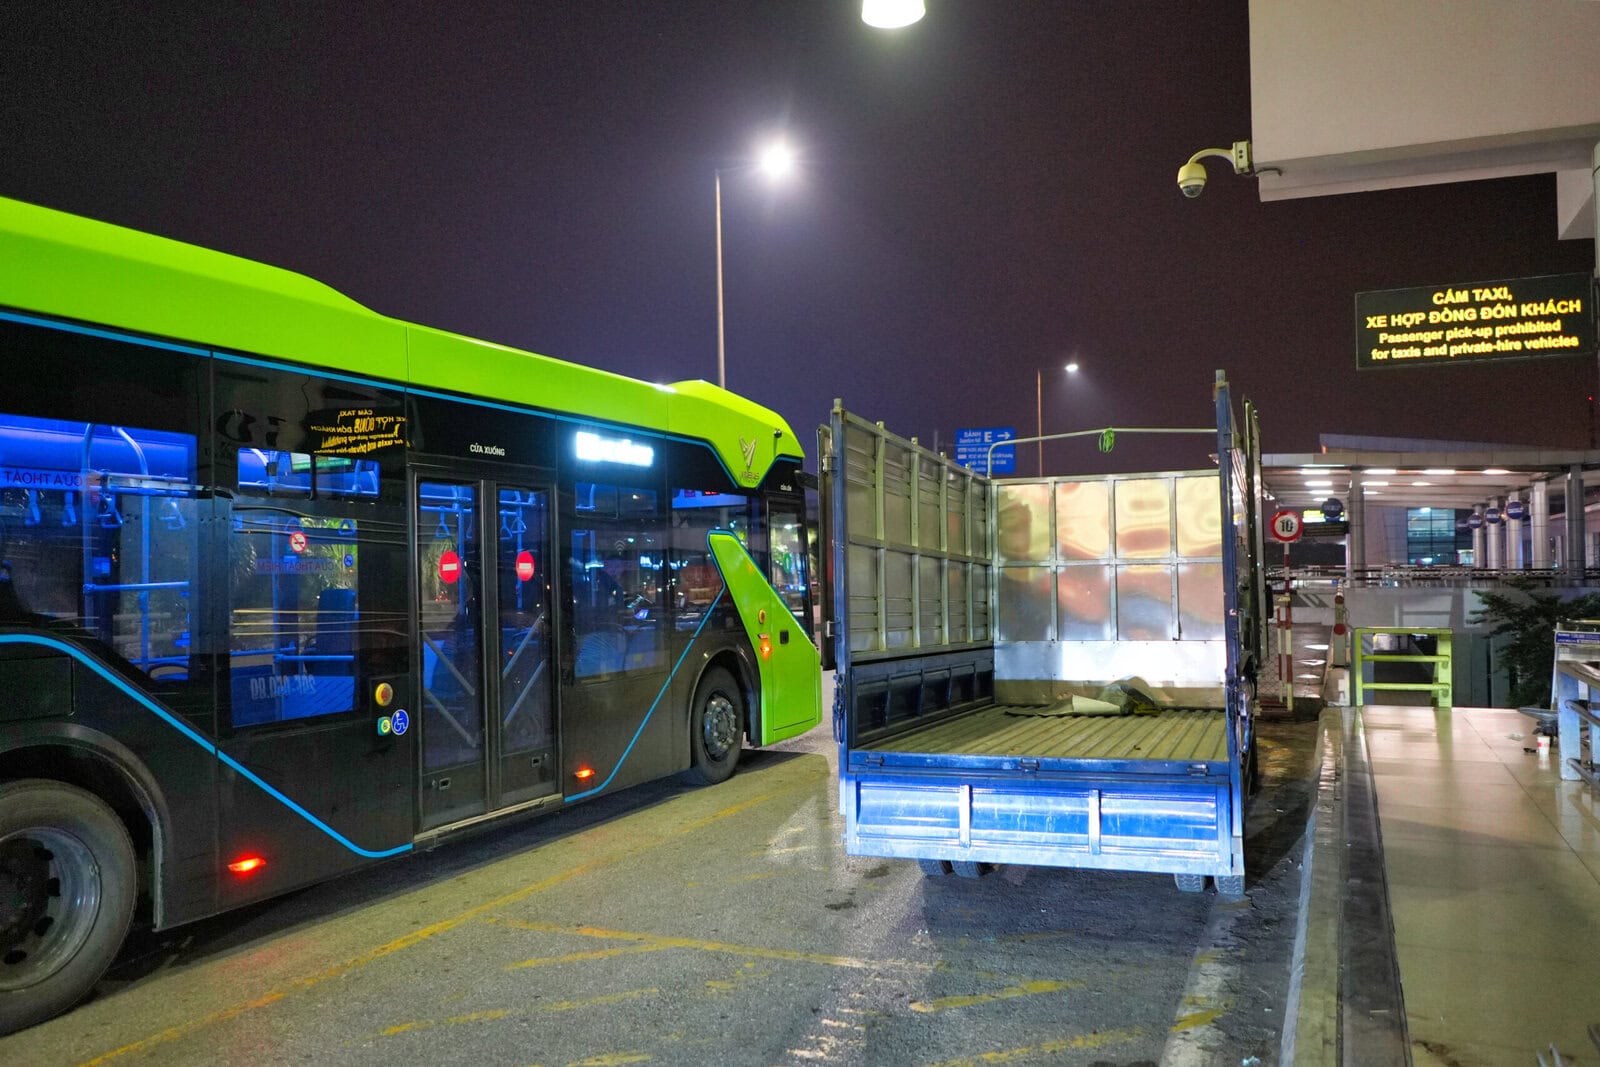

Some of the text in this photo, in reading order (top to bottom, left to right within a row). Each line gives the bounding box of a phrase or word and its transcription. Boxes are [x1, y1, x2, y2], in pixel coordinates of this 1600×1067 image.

[1472, 286, 1513, 302] TAXI,
[1366, 315, 1387, 328] XE
[1391, 312, 1426, 328] HỢP
[1480, 303, 1517, 319] ĐÓN
[1521, 298, 1581, 316] KHÁCH
[1379, 319, 1561, 344] Passenger pick-up prohibited
[1371, 335, 1579, 360] for taxis and private-hire vehicles
[984, 431, 993, 442] E
